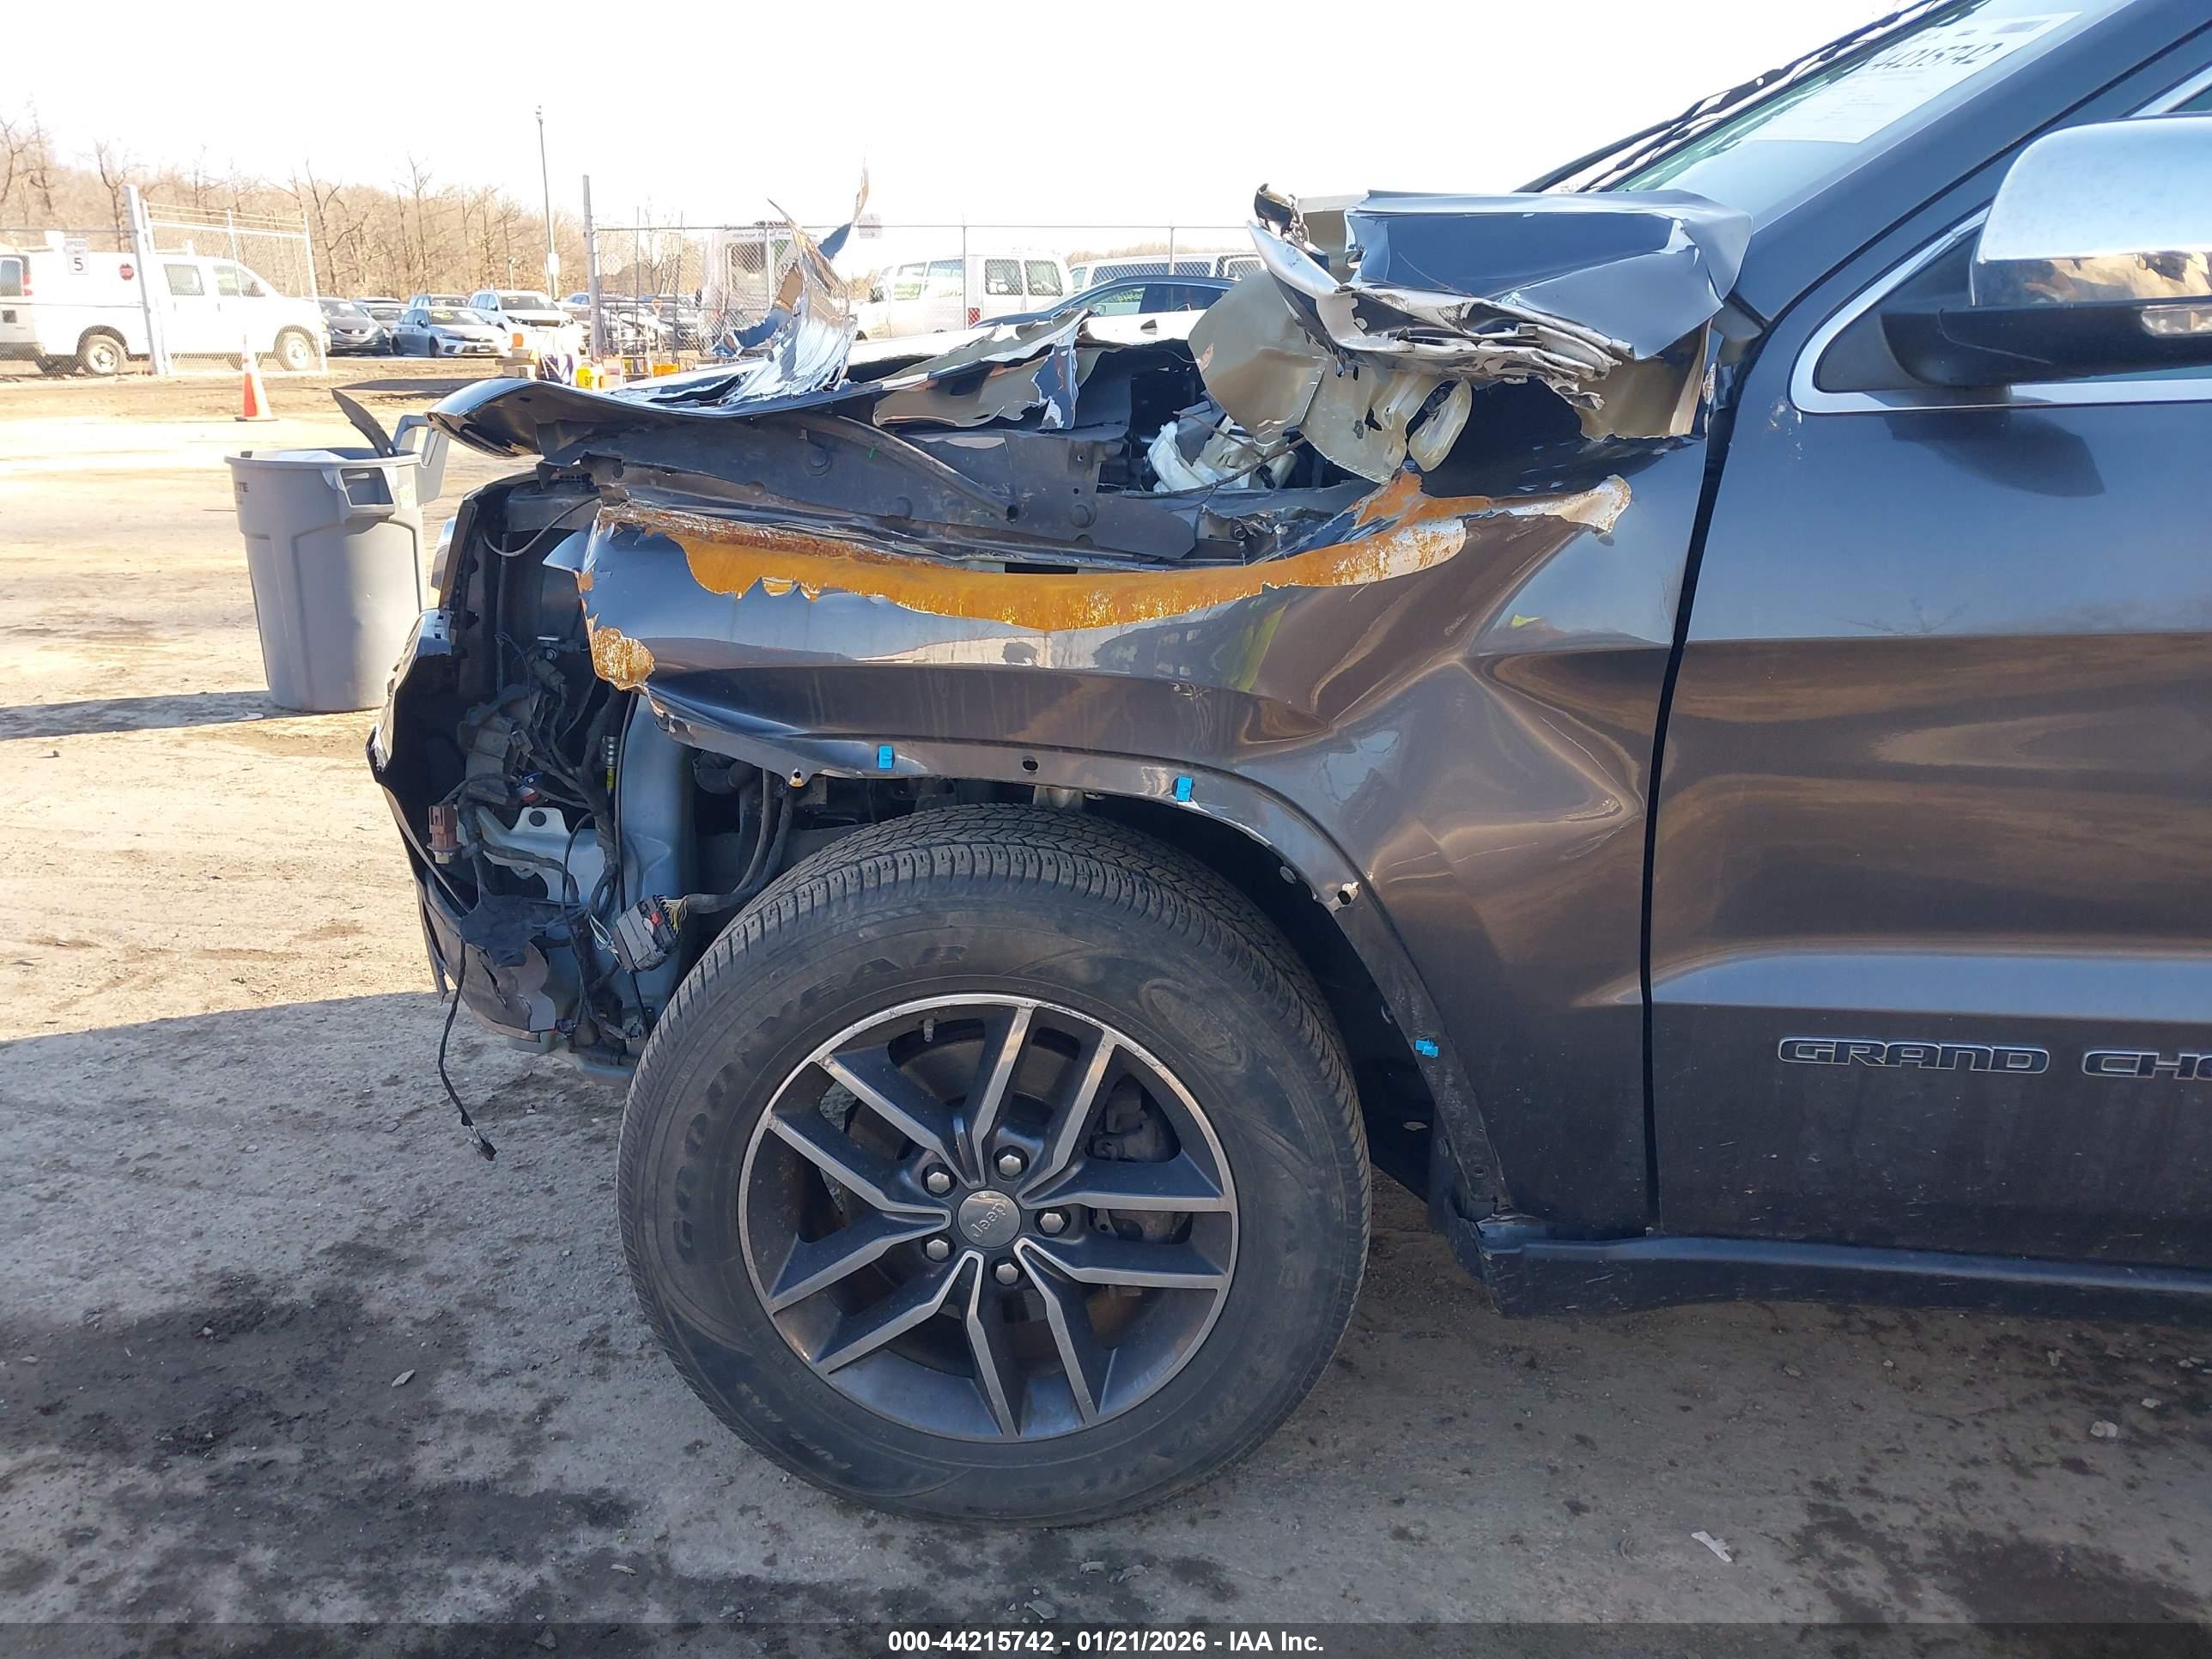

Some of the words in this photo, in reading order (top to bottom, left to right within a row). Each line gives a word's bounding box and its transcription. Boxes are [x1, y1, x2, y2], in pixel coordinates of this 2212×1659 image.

[73, 257, 84, 271] 5
[1778, 1036, 2051, 1074] GRAND
[2081, 1048, 2212, 1080] CH
[969, 1201, 1007, 1238] Jeep
